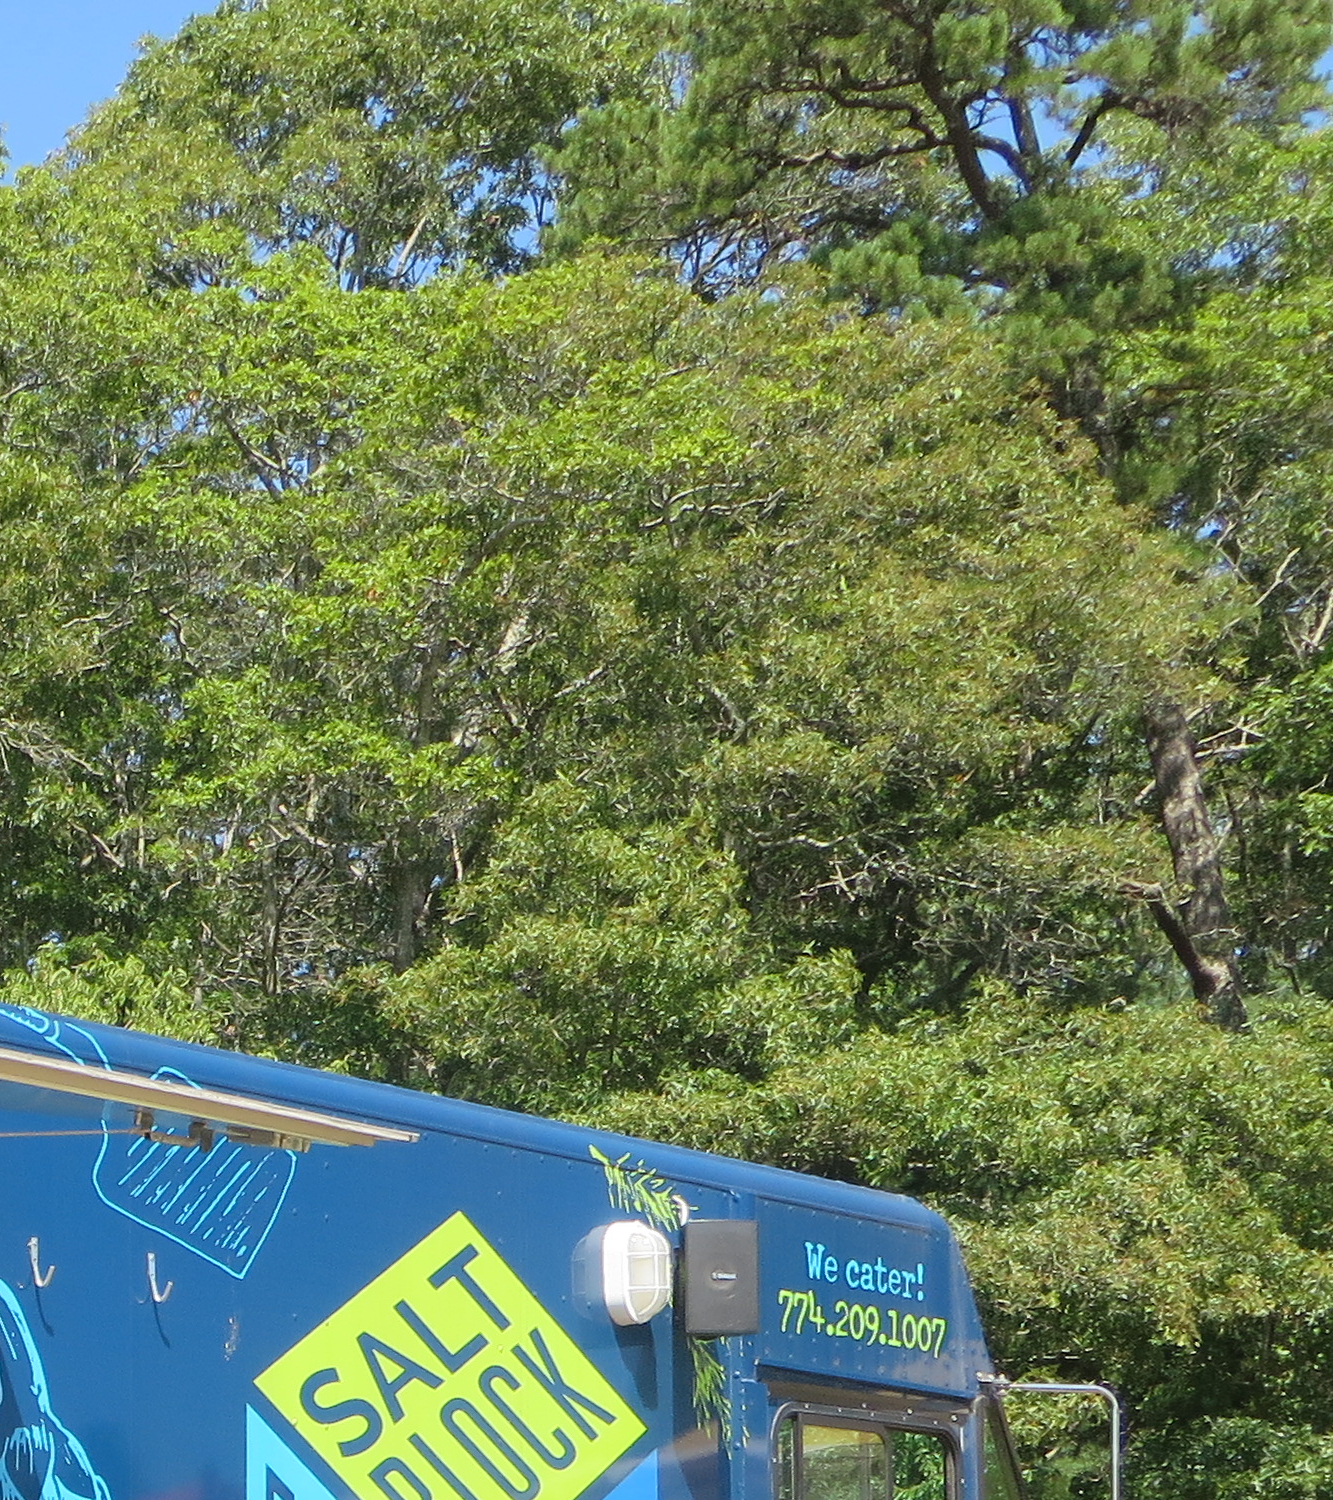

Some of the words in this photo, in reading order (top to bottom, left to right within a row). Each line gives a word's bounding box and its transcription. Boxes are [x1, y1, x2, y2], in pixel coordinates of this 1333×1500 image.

[804, 1242, 838, 1282] We
[846, 1257, 925, 1301] cater!
[299, 1244, 513, 1457] SALT
[778, 1289, 947, 1359] 774.209.1007
